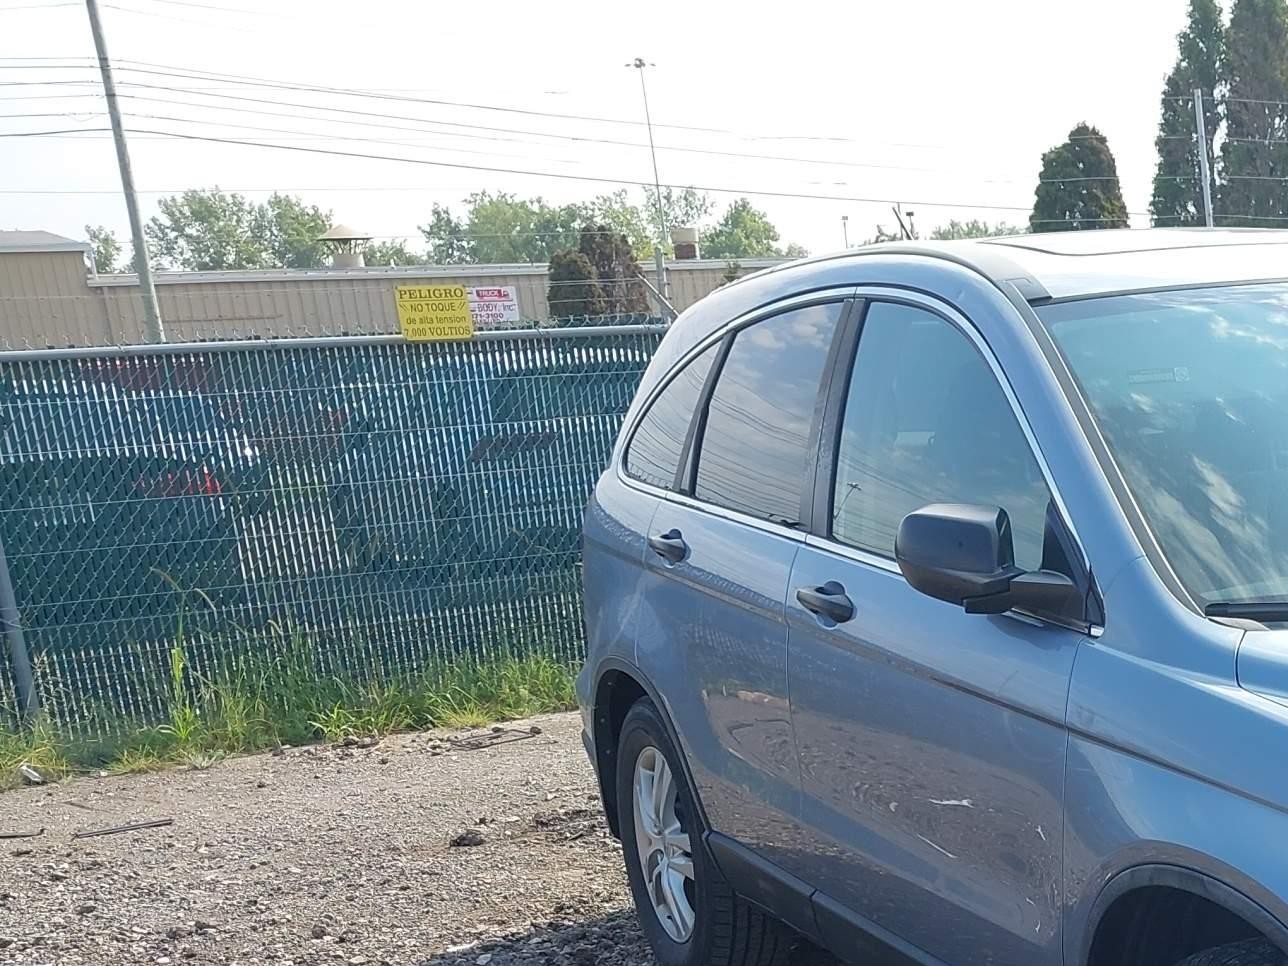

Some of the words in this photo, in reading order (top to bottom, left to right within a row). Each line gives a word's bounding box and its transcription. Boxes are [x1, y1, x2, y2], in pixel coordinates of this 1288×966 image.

[399, 288, 464, 299] PELIGRO
[410, 303, 424, 312] NO
[425, 302, 456, 312] TOQUE
[406, 316, 416, 324] de
[419, 315, 433, 324] alta
[436, 315, 466, 324] tension
[428, 326, 471, 336] VOLTIOS
